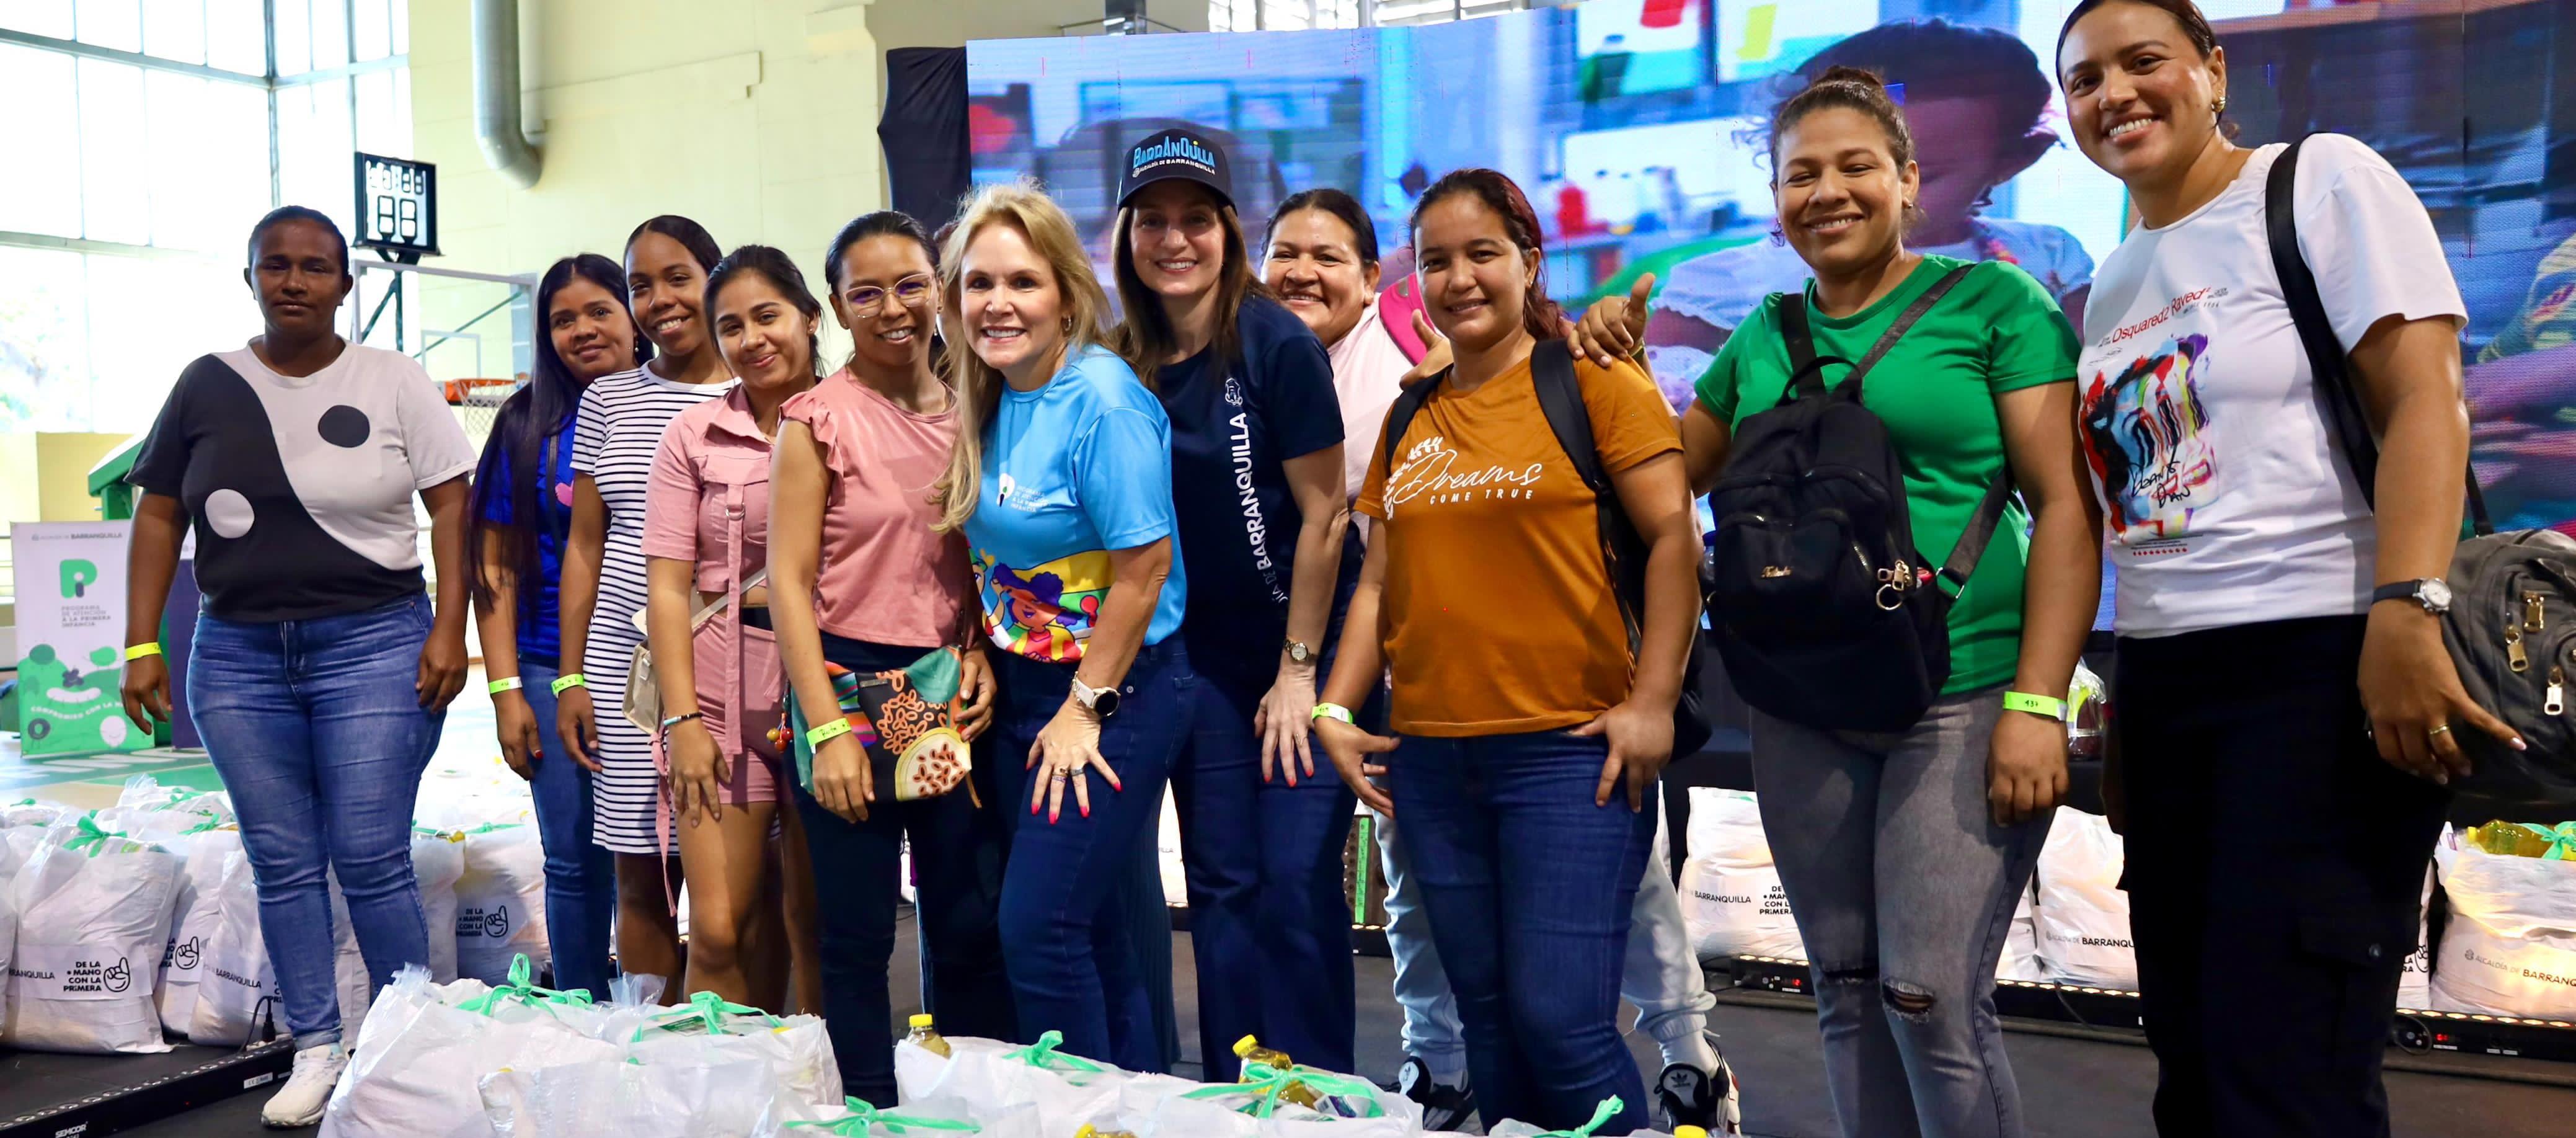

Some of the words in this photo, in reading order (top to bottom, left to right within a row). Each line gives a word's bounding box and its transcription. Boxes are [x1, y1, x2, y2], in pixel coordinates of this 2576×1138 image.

[1166, 159, 1215, 174] BARRANQUILLA
[1393, 449, 1543, 504] Dreams
[1229, 412, 1272, 570] BARRANQUILLA
[1430, 492, 1472, 505] COME
[1485, 489, 1533, 500] TRUE
[1694, 890, 1751, 904] BARRANQUILLA
[2082, 937, 2135, 948] BARRANQU
[2522, 969, 2576, 987] BARRANQ
